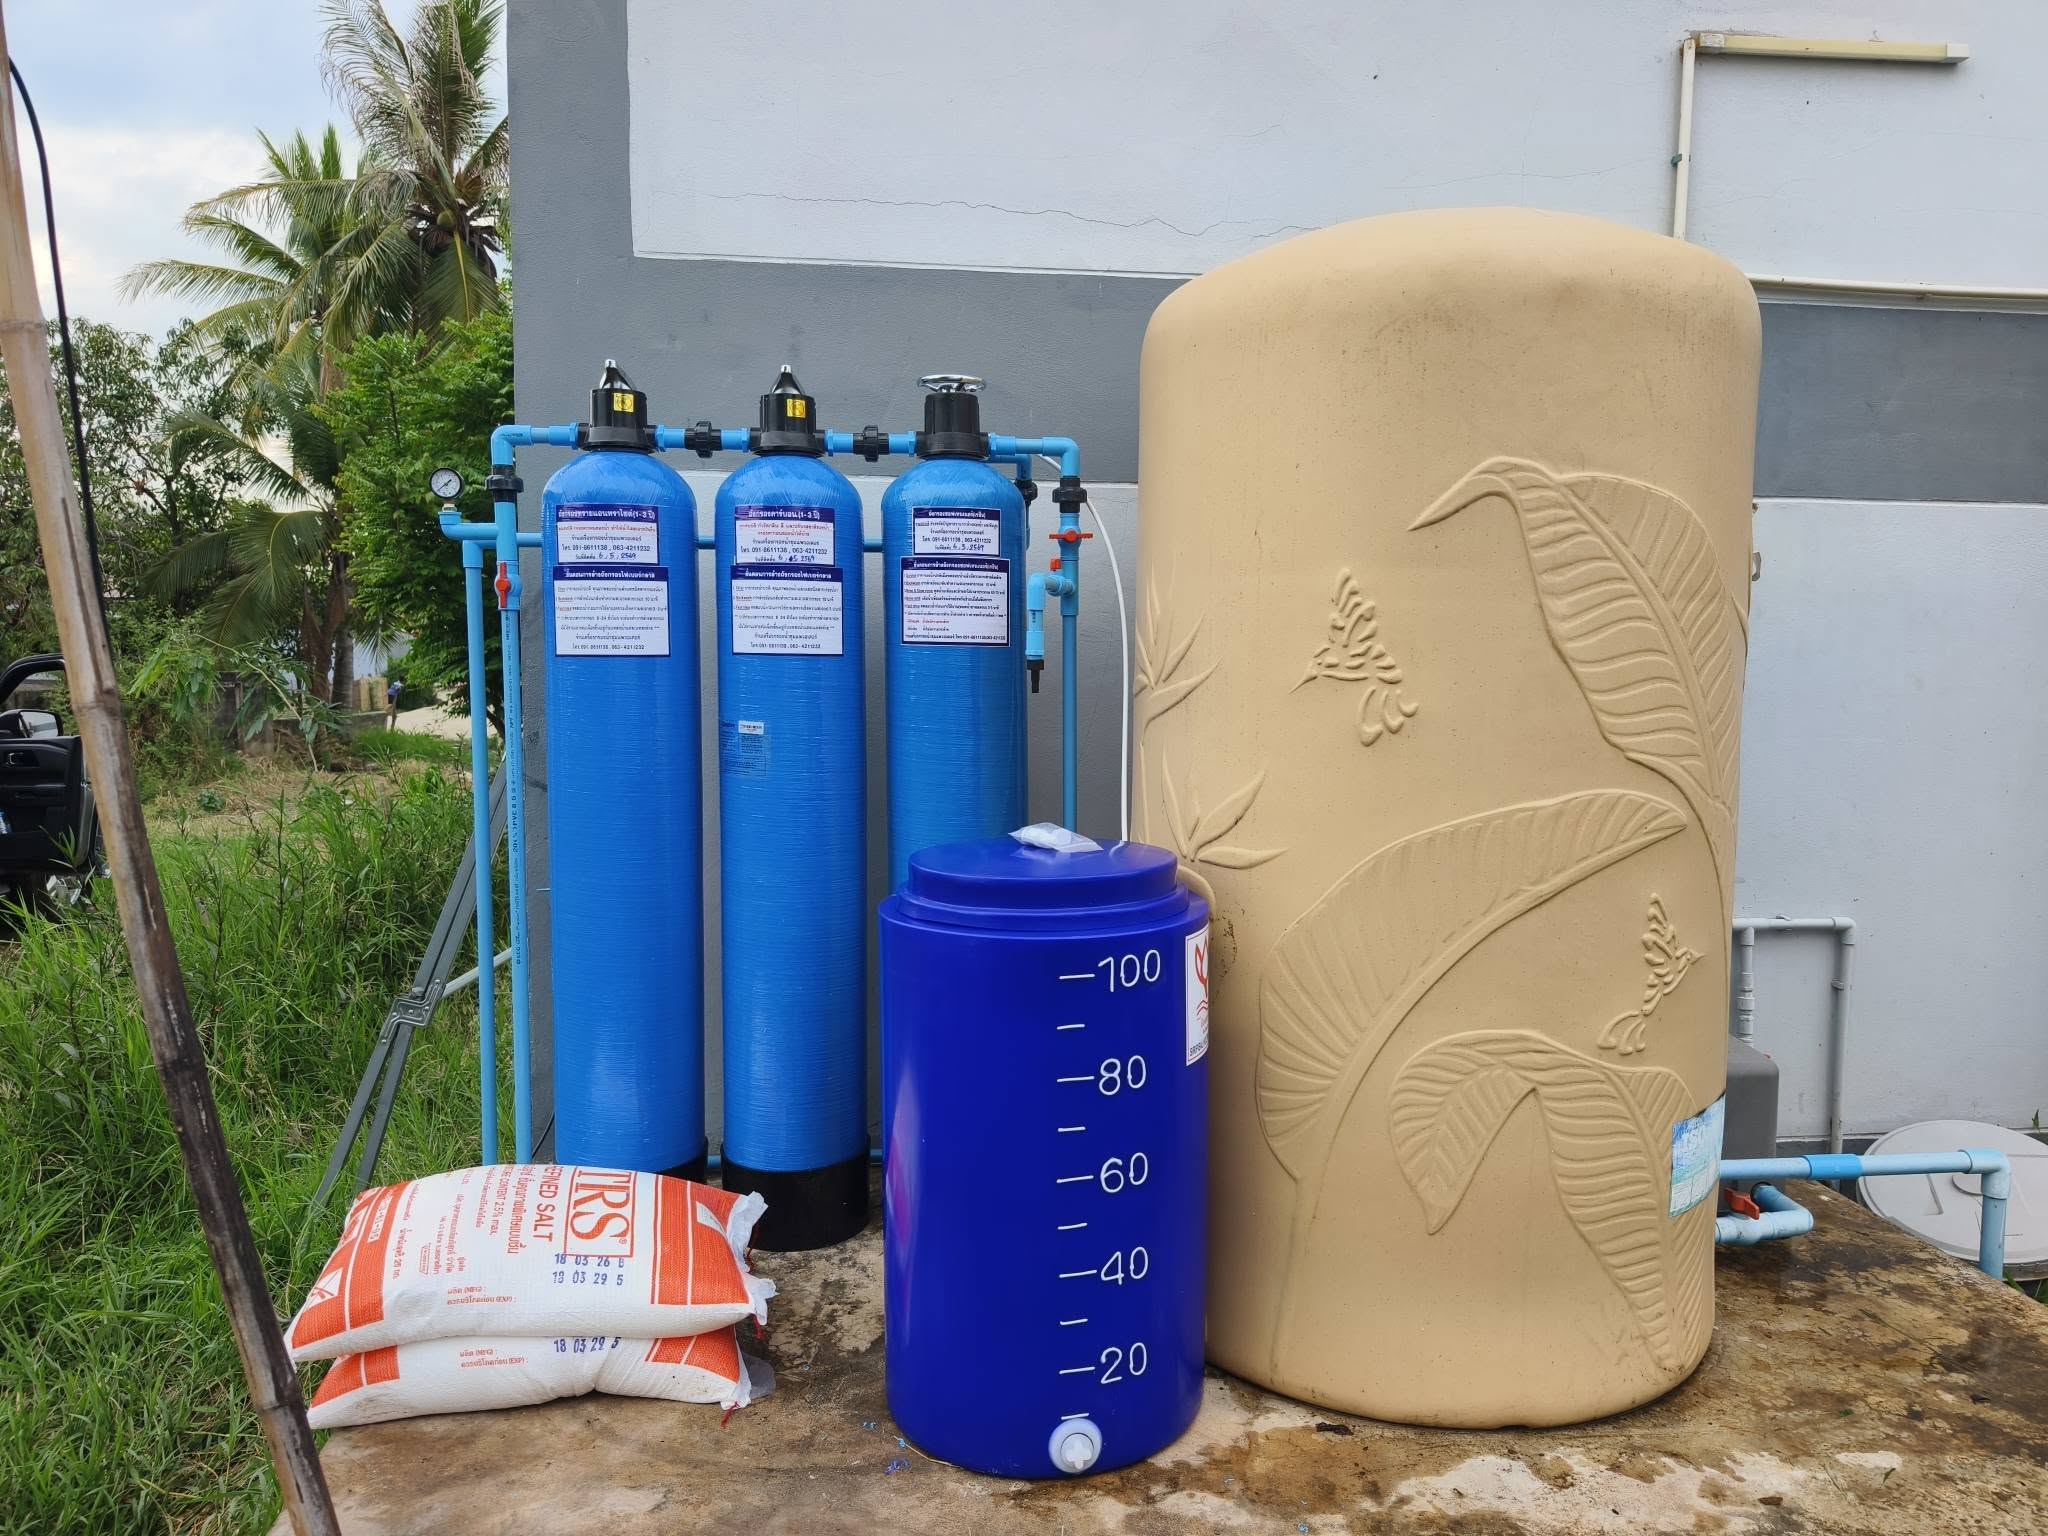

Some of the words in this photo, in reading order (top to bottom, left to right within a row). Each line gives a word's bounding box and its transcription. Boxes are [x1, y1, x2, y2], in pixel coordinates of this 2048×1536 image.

[1098, 950, 1160, 992] 100
[1099, 1055, 1146, 1095] 80
[496, 1178, 510, 1200] CONTENT
[1100, 1152, 1148, 1193] 60
[492, 1202, 505, 1218] 2.5%
[532, 1203, 556, 1242] SALT
[554, 1252, 566, 1264] 18
[1100, 1246, 1149, 1285] 40
[593, 1272, 608, 1285] 29
[616, 1274, 624, 1286] 5
[554, 1338, 566, 1352] 18
[574, 1338, 587, 1354] 03
[611, 1336, 622, 1349] 5
[1100, 1342, 1147, 1384] 20
